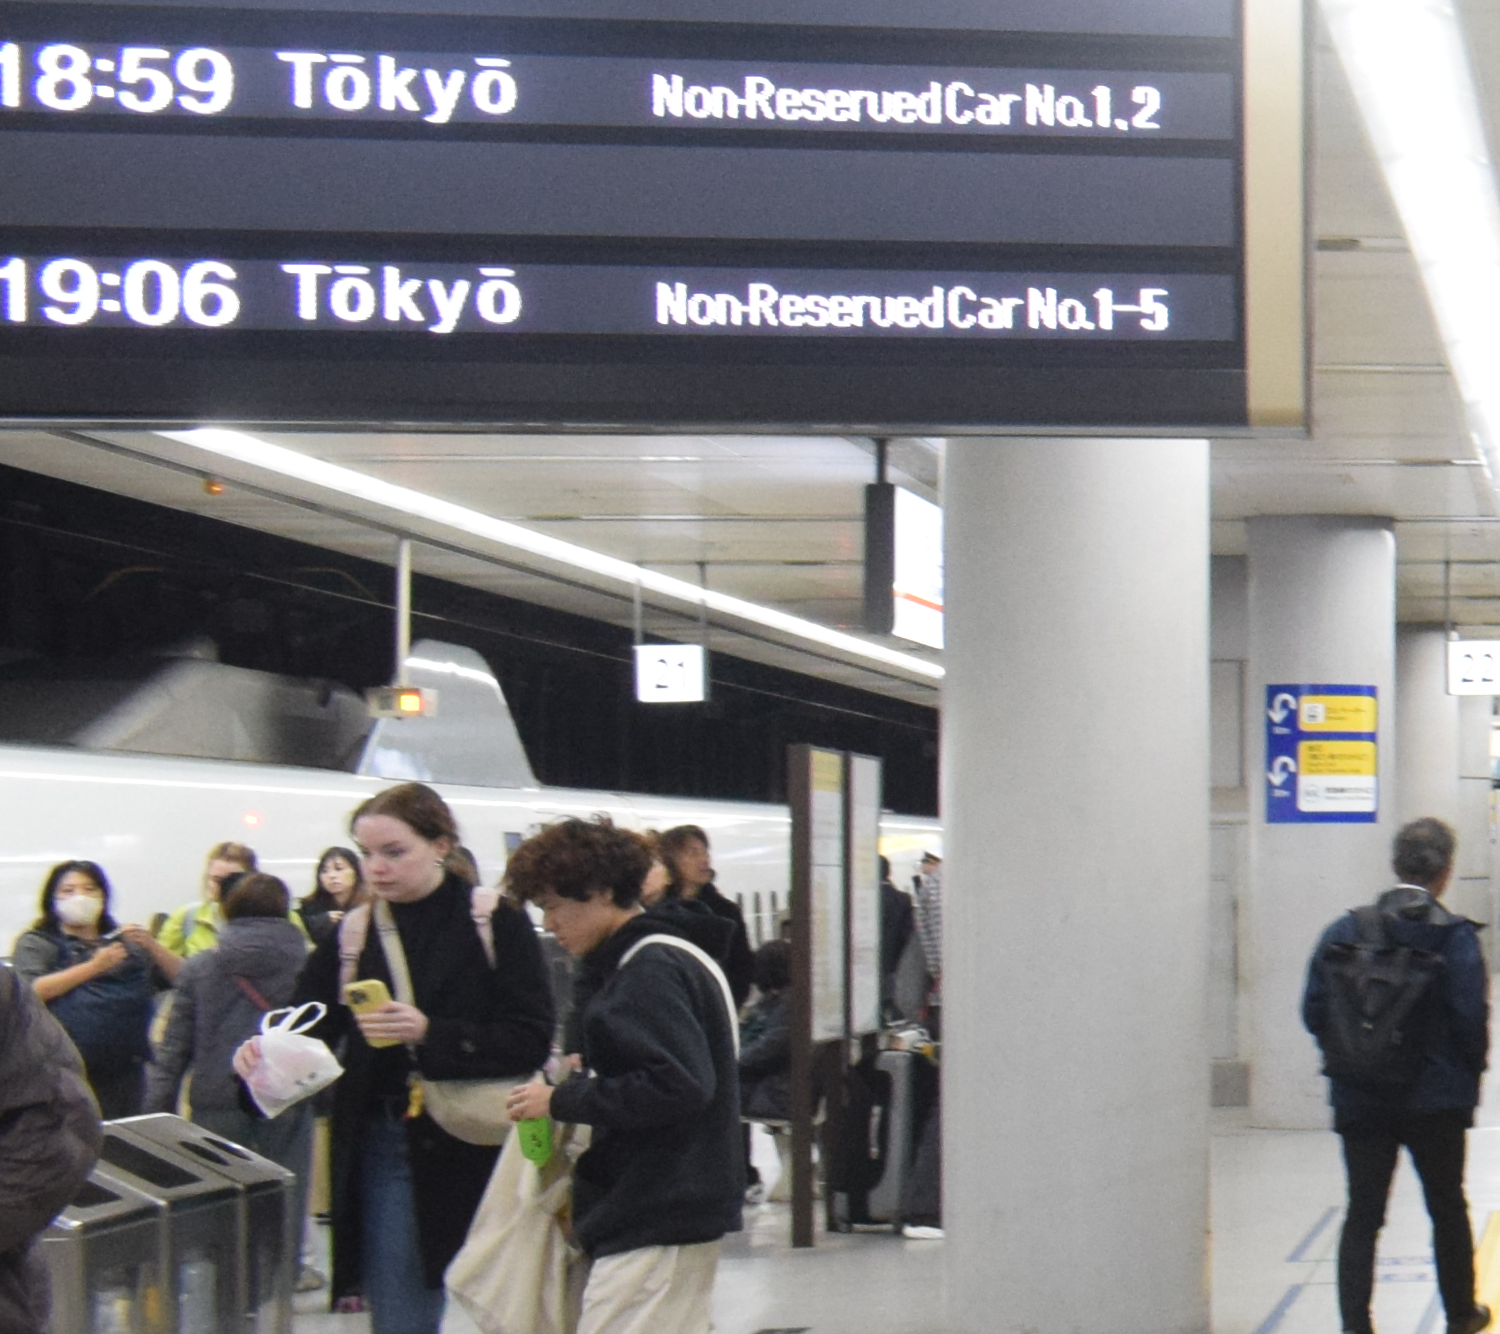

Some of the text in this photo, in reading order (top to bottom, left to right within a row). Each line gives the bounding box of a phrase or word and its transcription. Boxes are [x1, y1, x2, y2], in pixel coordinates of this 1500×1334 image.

[0, 42, 519, 125] 18:59 Tōkyō
[944, 81, 1023, 126] Car
[0, 257, 524, 334] 19:06 Tōkyō
[946, 285, 1025, 330] Car
[655, 658, 686, 688] 21
[1460, 654, 1494, 682] 22
